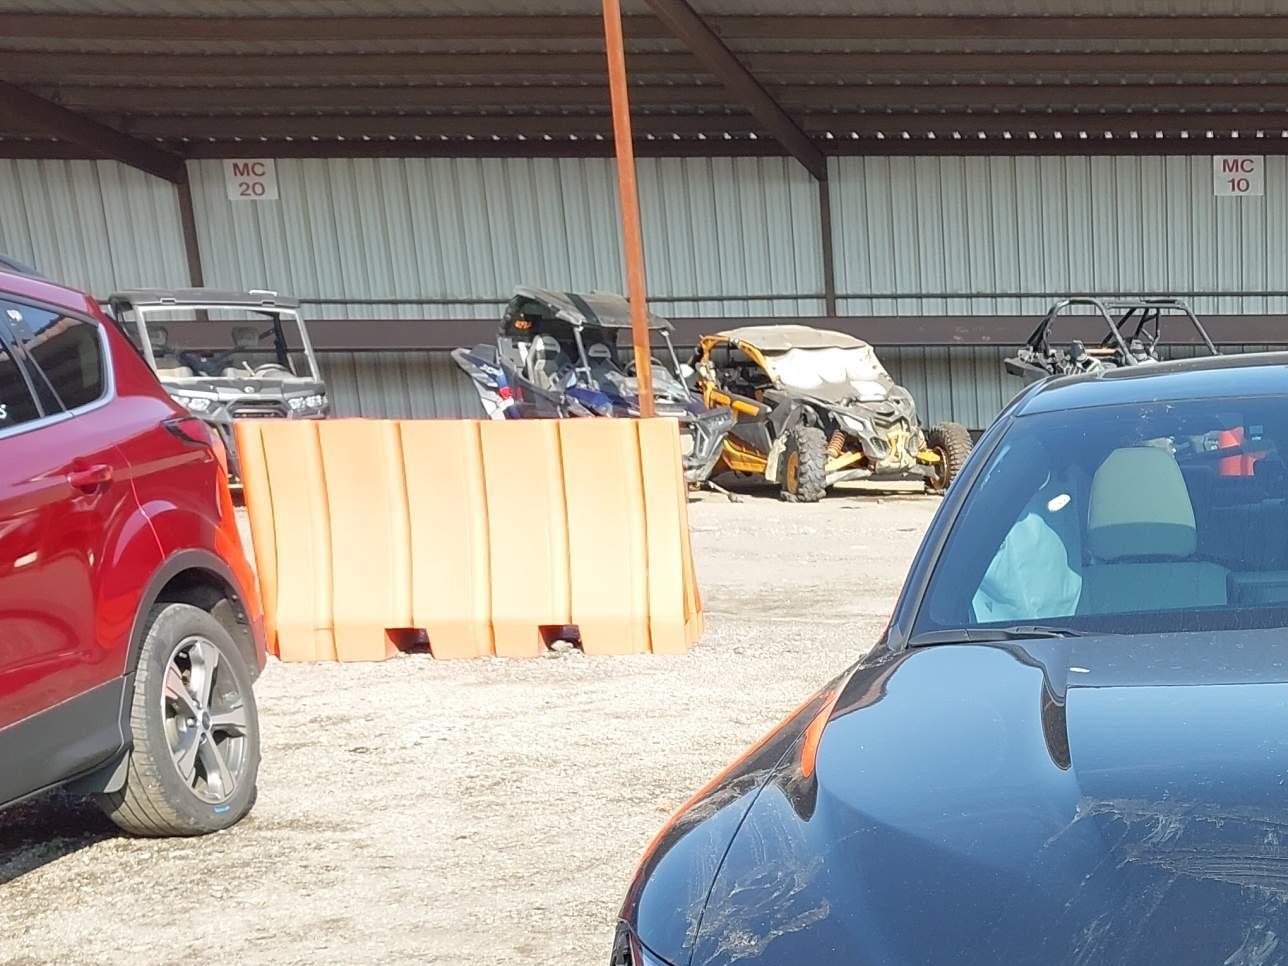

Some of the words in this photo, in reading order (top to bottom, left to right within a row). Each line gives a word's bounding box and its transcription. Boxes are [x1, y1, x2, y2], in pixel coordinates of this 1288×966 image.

[232, 162, 267, 177] MC
[1222, 159, 1255, 173] MC
[238, 182, 266, 196] 20
[1227, 178, 1250, 192] 10
